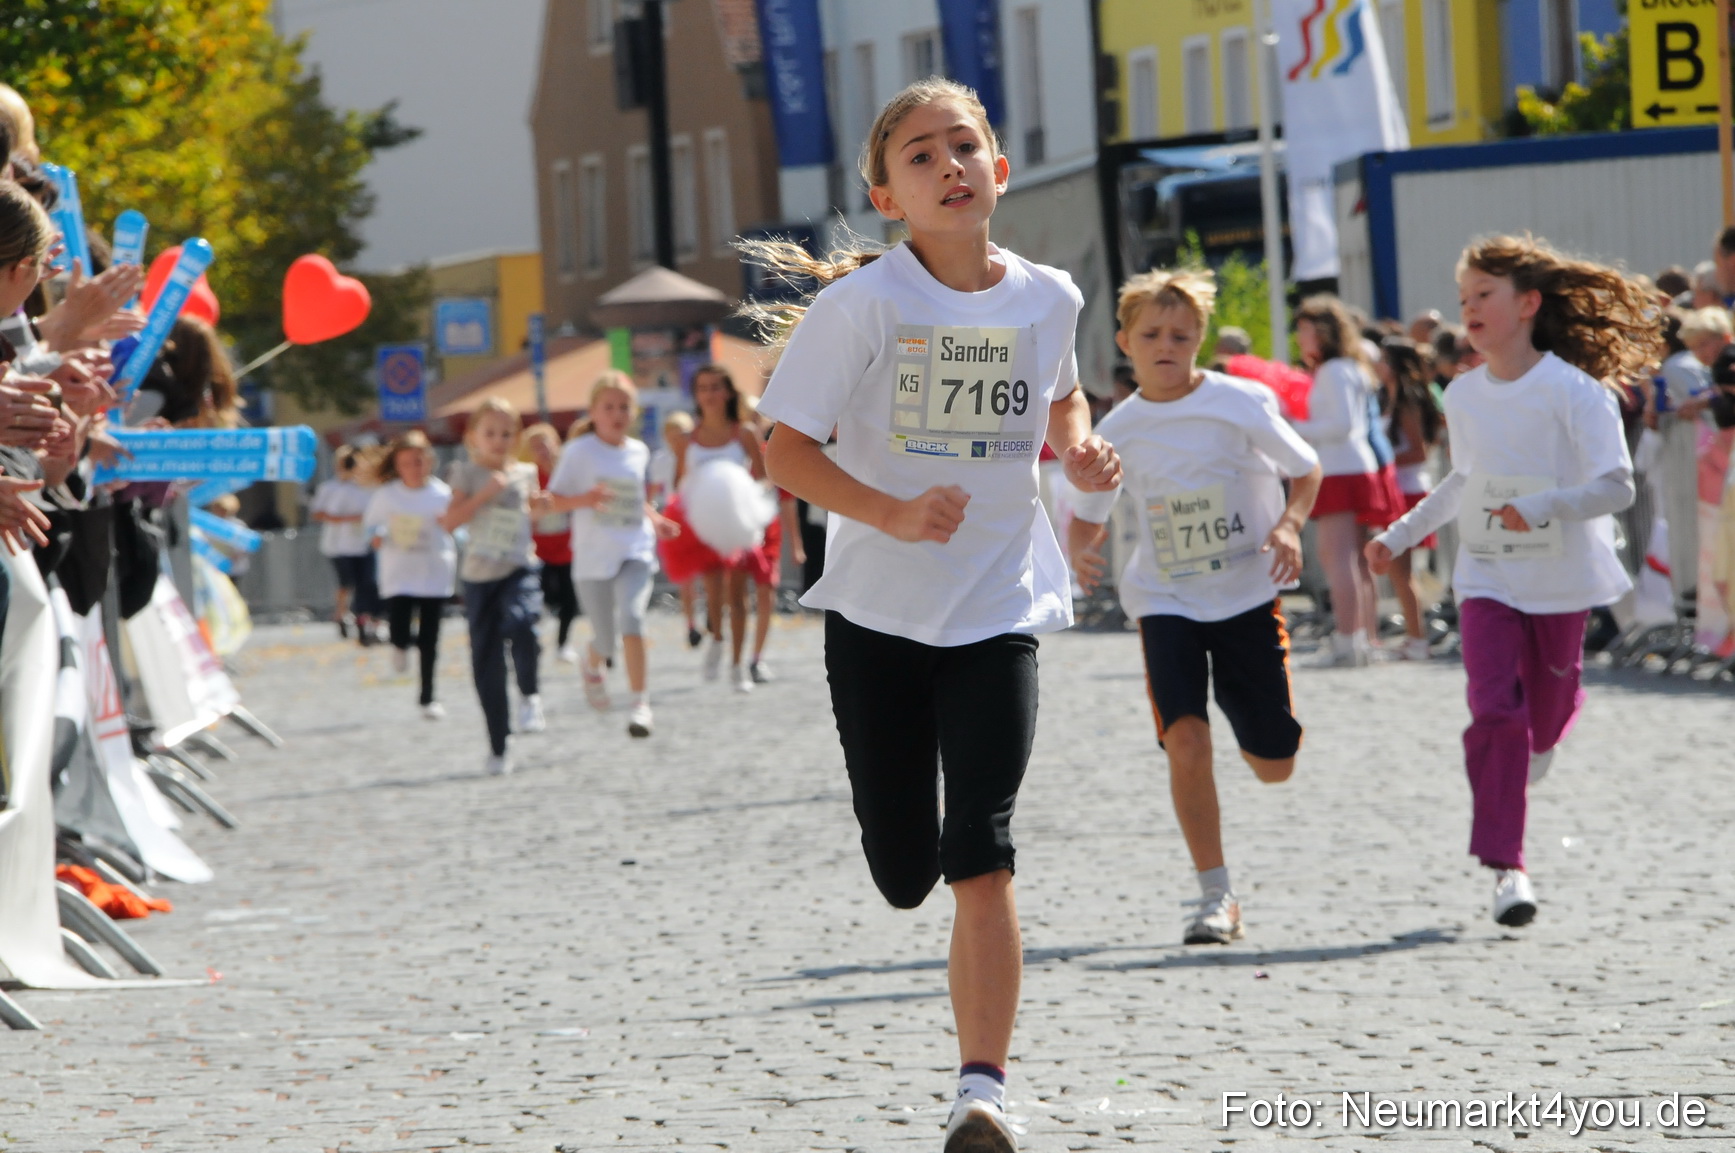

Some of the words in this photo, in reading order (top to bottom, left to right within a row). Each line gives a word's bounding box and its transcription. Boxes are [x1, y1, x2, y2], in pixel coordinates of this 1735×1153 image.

[1656, 22, 1704, 91] B
[940, 336, 1008, 363] Sandra
[899, 374, 919, 393] K5
[941, 379, 1029, 416] 7169
[905, 439, 949, 452] BOCK
[988, 440, 1034, 452] PFLEIDERER
[1170, 497, 1210, 516] Maria
[1178, 512, 1245, 548] 7164
